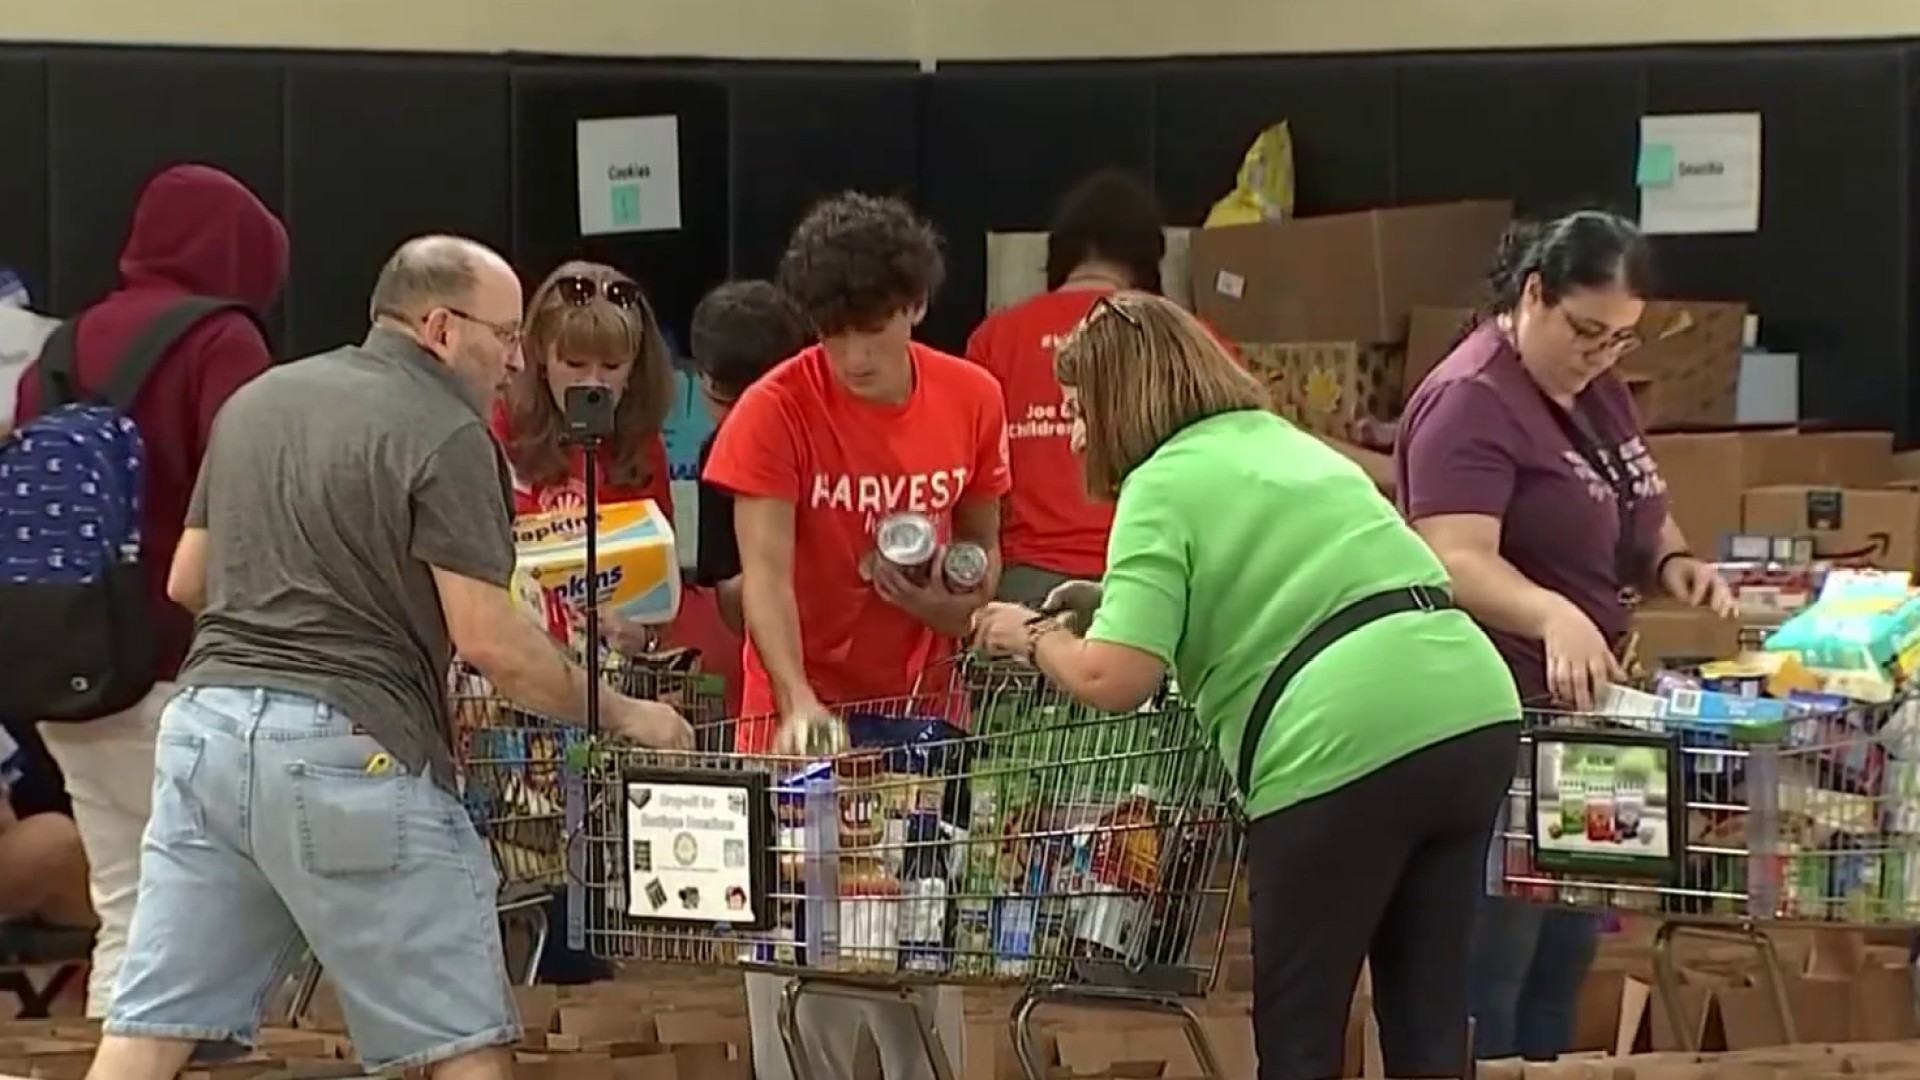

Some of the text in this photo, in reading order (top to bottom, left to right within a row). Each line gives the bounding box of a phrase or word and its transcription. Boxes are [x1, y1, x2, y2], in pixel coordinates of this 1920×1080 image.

[1026, 403, 1057, 419] Joe
[811, 466, 968, 511] HARVEST
[512, 514, 603, 542] apkin
